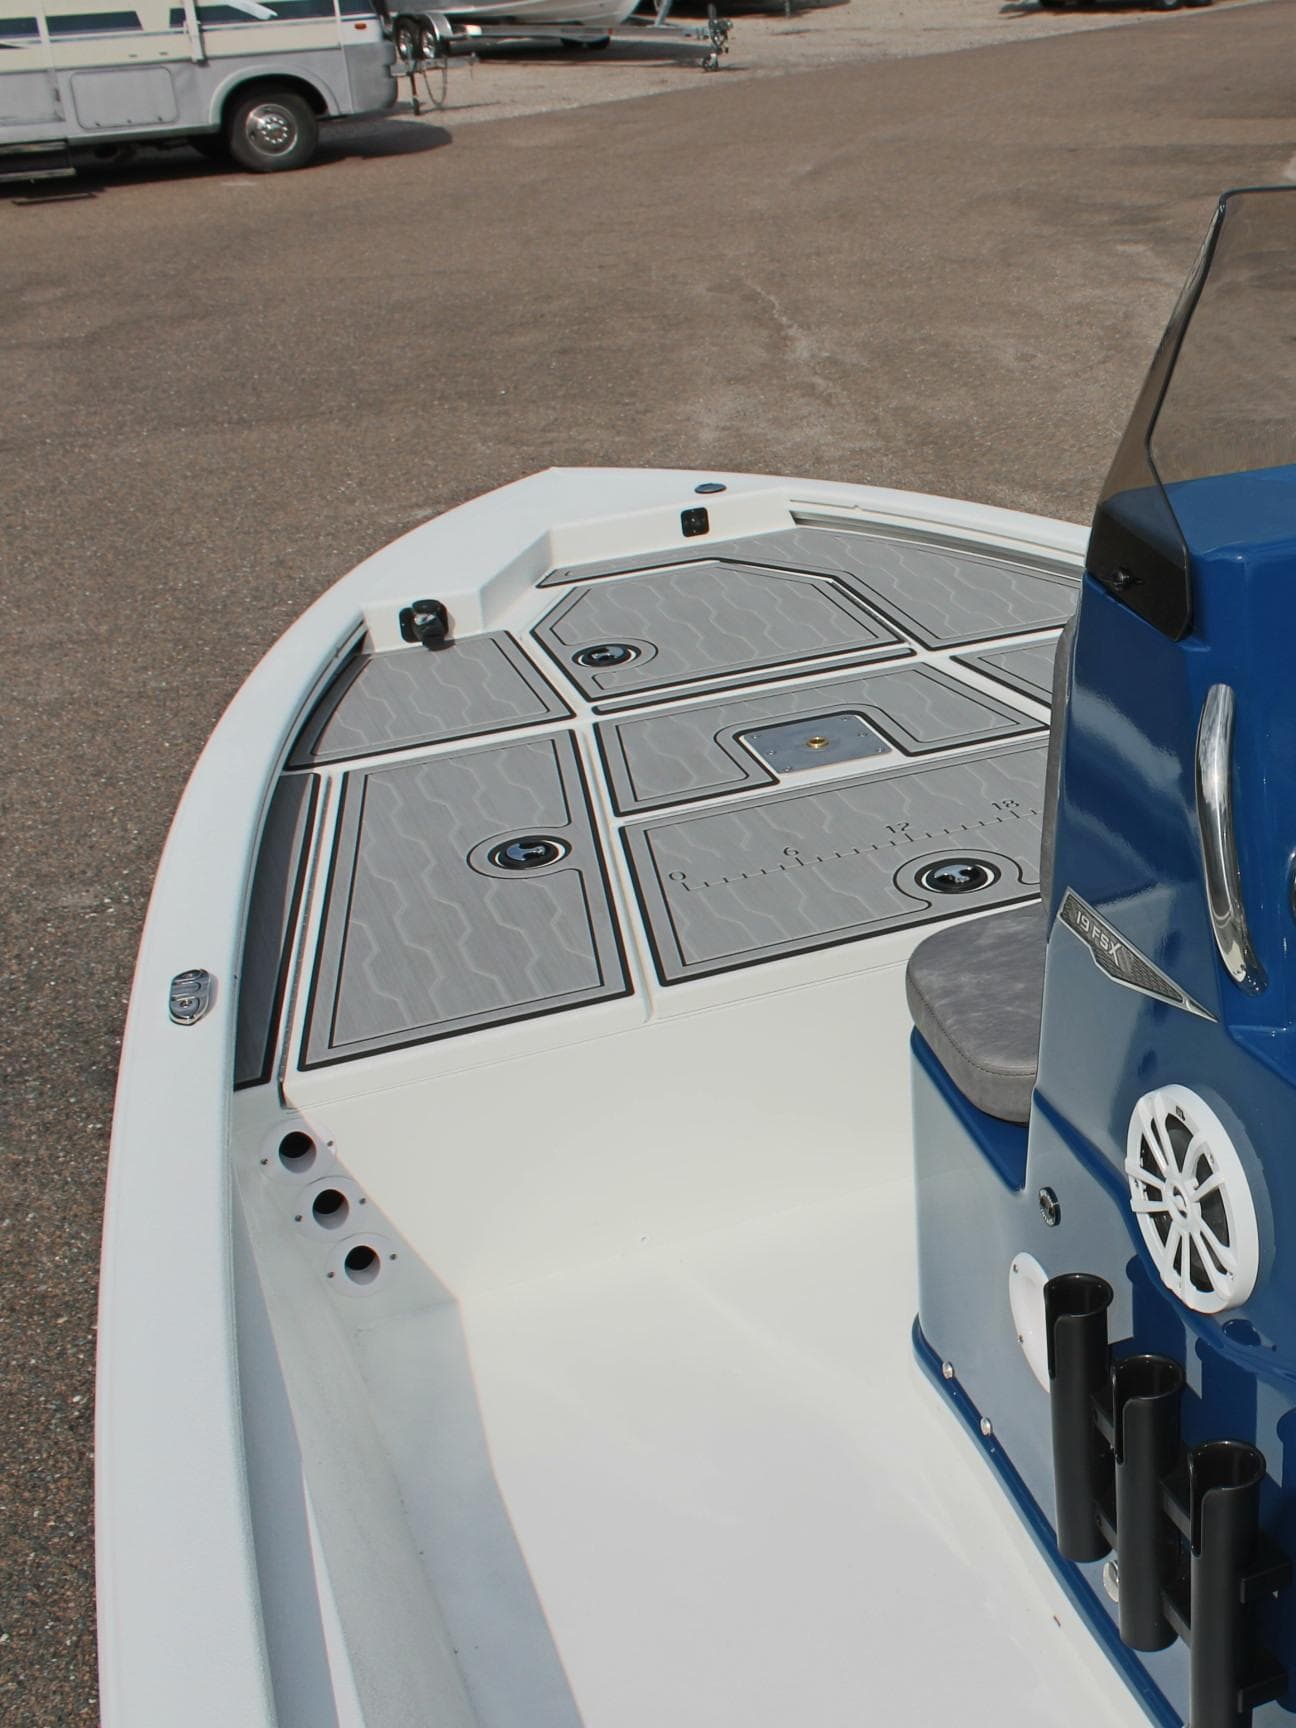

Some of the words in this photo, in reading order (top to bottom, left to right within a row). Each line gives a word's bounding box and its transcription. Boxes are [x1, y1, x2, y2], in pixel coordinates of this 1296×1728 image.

[992, 799, 1020, 812] 18
[886, 821, 911, 835] 12
[783, 845, 800, 857] 6
[1076, 910, 1091, 933] 19
[1092, 924, 1122, 966] FSX
